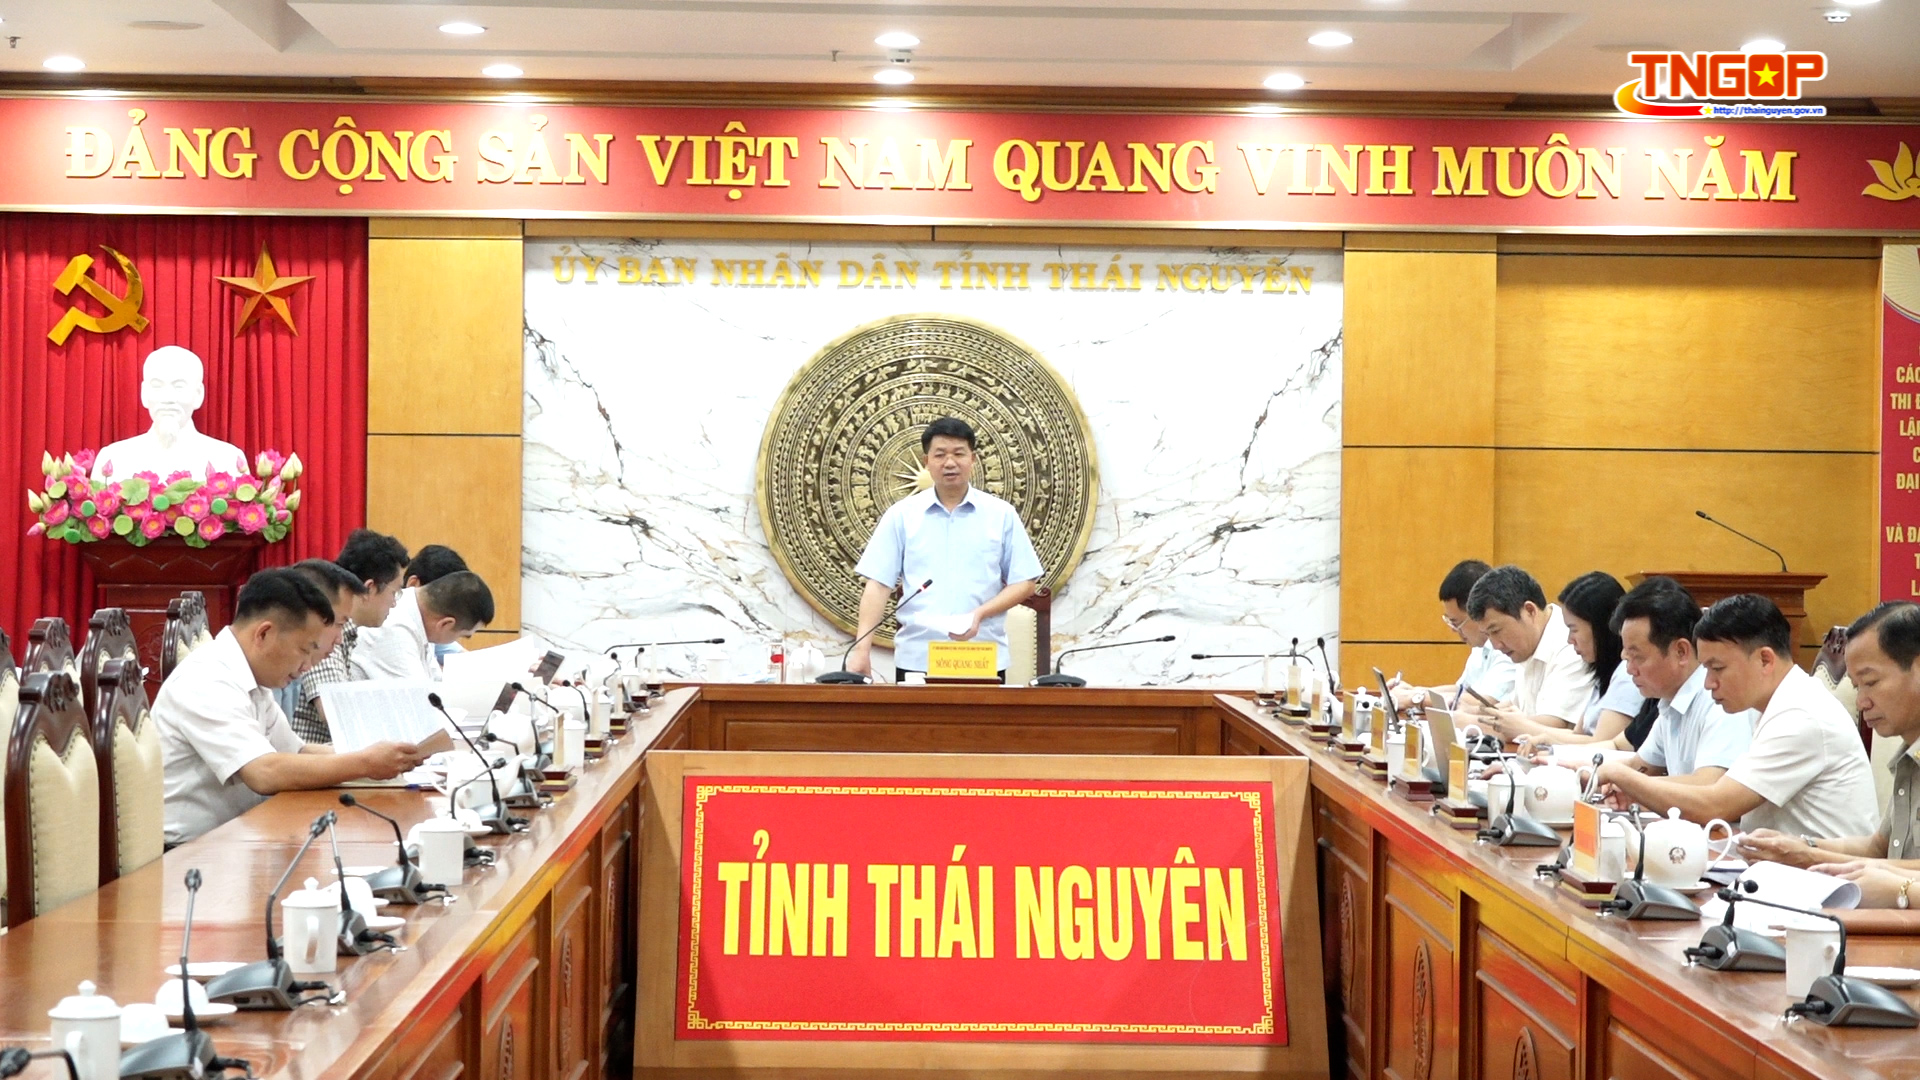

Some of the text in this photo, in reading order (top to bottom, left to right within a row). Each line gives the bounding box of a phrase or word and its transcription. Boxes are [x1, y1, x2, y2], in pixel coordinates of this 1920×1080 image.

[65, 109, 1798, 201] ĐẢNG CỘNG SẢN VIỆT NAM QUANG VINH MUÔN NĂM
[552, 245, 1314, 293] ỦY BAN NHÂN DÂN TỈNH THÁI NGUYÊN
[1890, 393, 1912, 410] THI
[1896, 473, 1920, 494] ĐẠI
[1886, 522, 1904, 543] VÀ
[952, 659, 973, 670] QUANG
[718, 829, 1249, 962] TỈNH THÁI NGUYÊN
